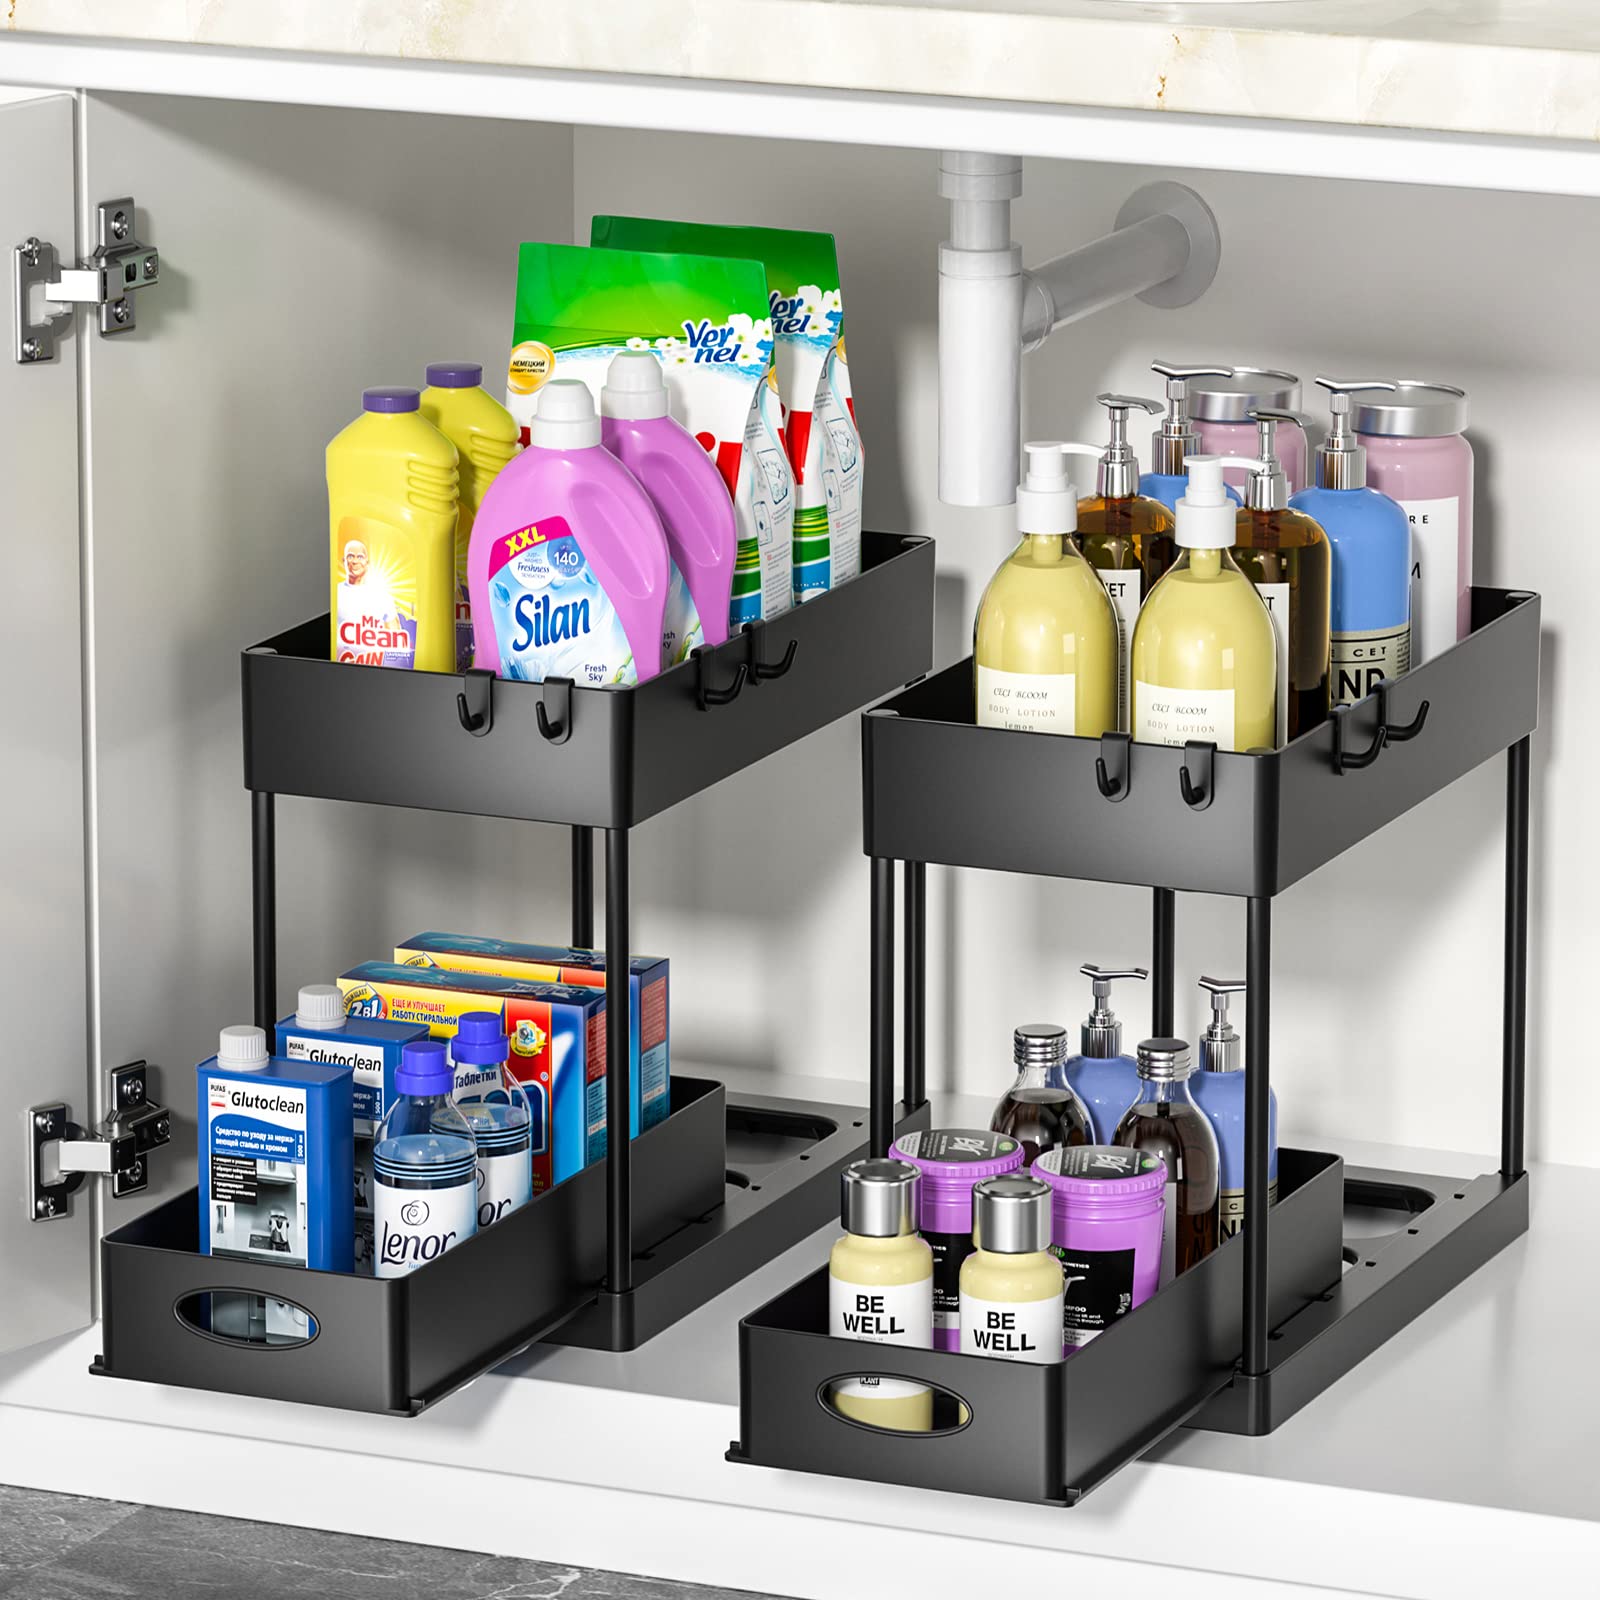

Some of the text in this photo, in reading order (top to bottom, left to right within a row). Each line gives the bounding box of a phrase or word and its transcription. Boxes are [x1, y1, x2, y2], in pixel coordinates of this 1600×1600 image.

[685, 321, 734, 348] Ver
[694, 344, 742, 363] nel
[504, 526, 546, 557] XXL
[517, 562, 550, 573] Freshness
[554, 551, 579, 566] 140
[362, 615, 383, 629] Mr.
[512, 594, 591, 652] Silan
[340, 622, 408, 648] Clean
[584, 664, 607, 672] Fresh
[588, 673, 603, 682] Sky
[989, 704, 1056, 718] BODY LOTION
[1004, 721, 1034, 731] lemon
[1147, 720, 1215, 733] BODY LOTION
[392, 998, 445, 1012] ЕЩЕ И УЛУЧШАЕТ
[392, 1010, 457, 1026] РАБОТУ СТИРАЛЬНОЙ
[310, 1049, 381, 1071] Glutoclean
[455, 1070, 497, 1089] Таблетки
[231, 1091, 304, 1114] Glutoclean
[380, 1221, 457, 1265] Lenor
[856, 1294, 885, 1314] BE
[843, 1312, 905, 1335] WELL
[986, 1311, 1016, 1331] BE
[973, 1329, 1036, 1352] WELL
